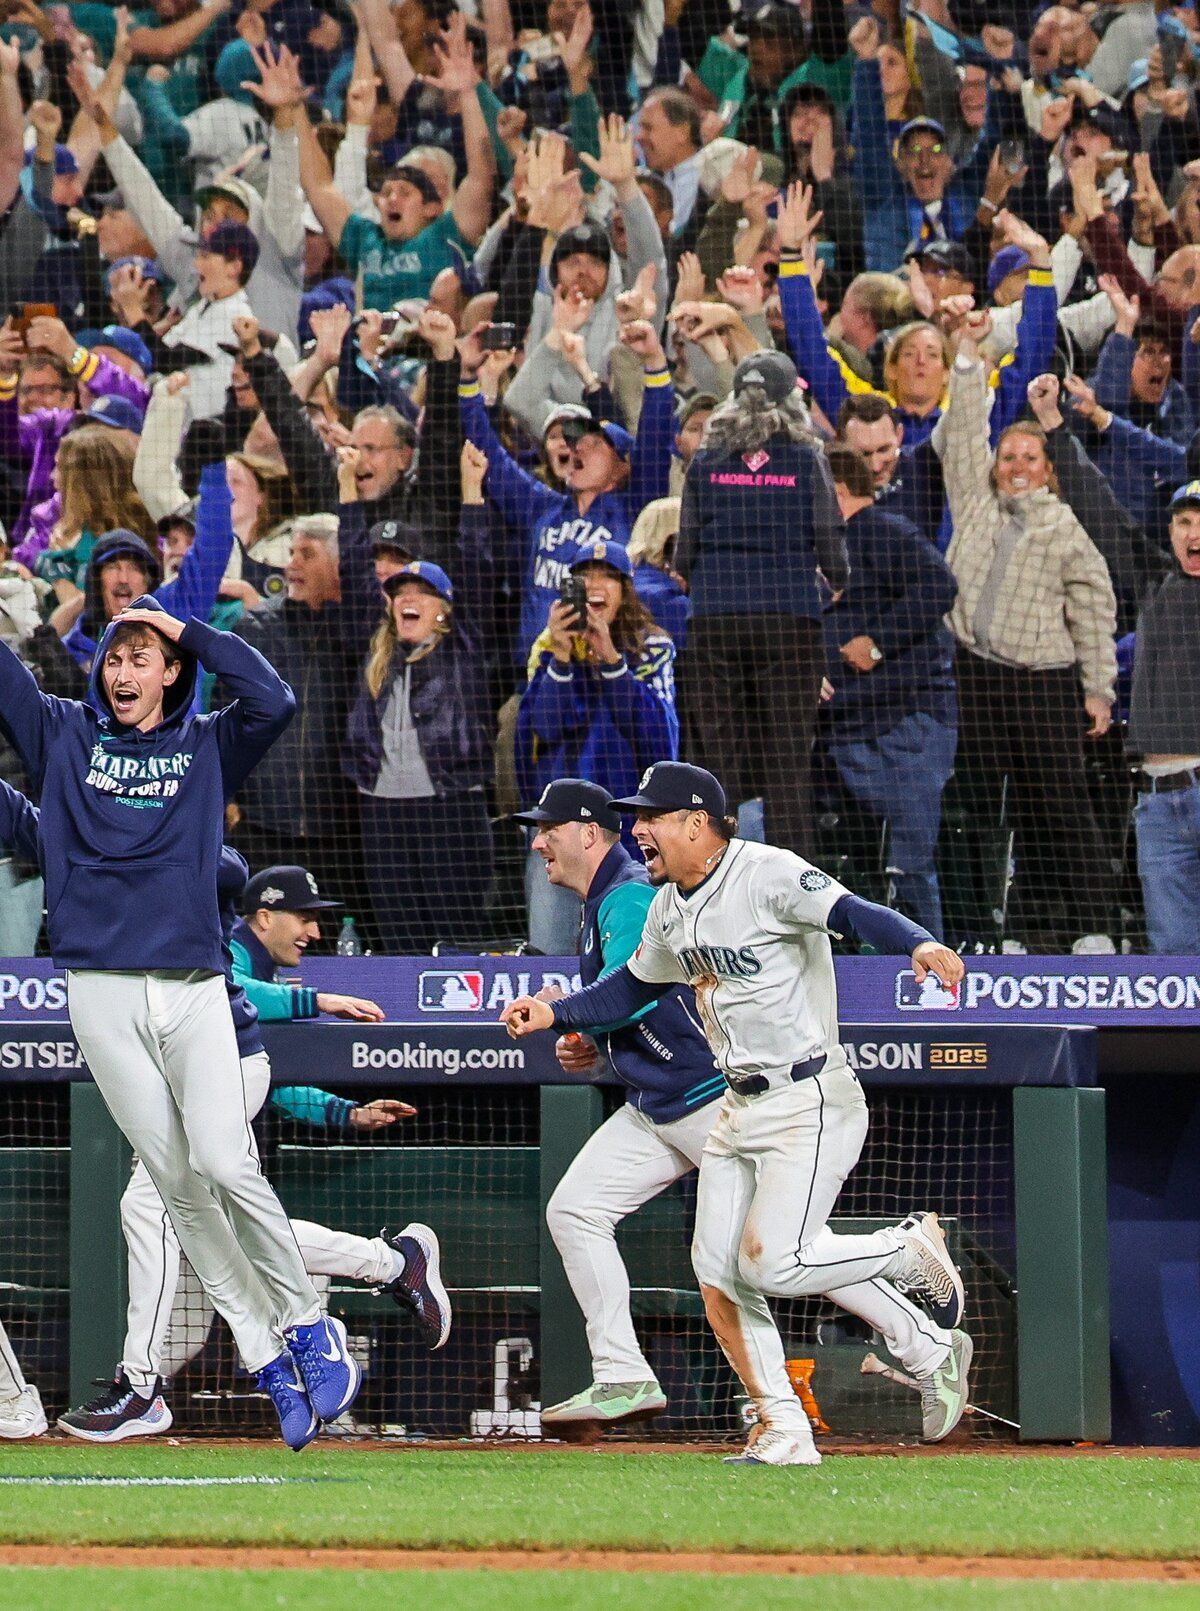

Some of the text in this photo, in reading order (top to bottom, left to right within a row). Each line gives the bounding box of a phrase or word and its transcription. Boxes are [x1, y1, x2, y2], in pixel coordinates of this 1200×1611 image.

[163, 779, 180, 797] FA
[638, 1022, 674, 1062] MARINERS
[352, 1041, 525, 1075] Booking.com
[929, 1049, 988, 1064] 2025
